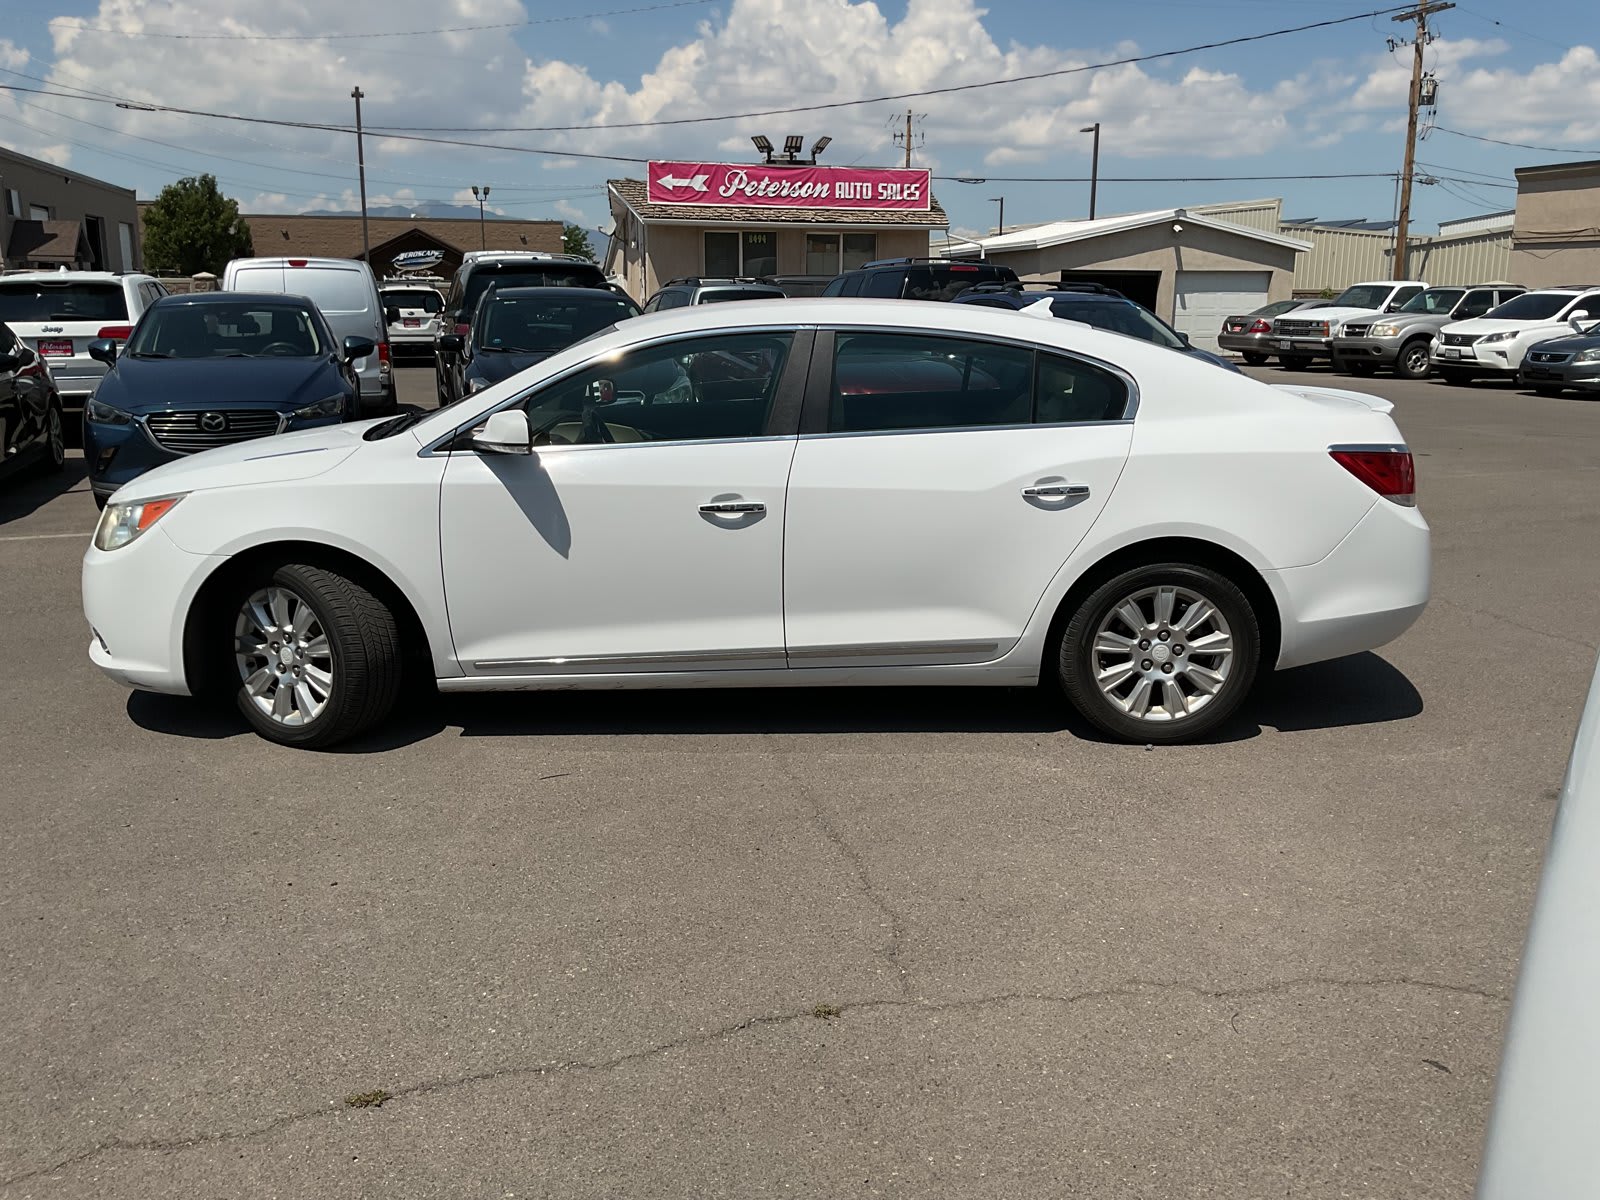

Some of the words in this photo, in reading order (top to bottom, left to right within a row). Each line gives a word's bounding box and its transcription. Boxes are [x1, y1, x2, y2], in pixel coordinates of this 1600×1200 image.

[719, 170, 830, 199] Peterson
[835, 182, 871, 199] AUTO
[877, 183, 920, 200] SALES
[41, 325, 64, 333] Jeep
